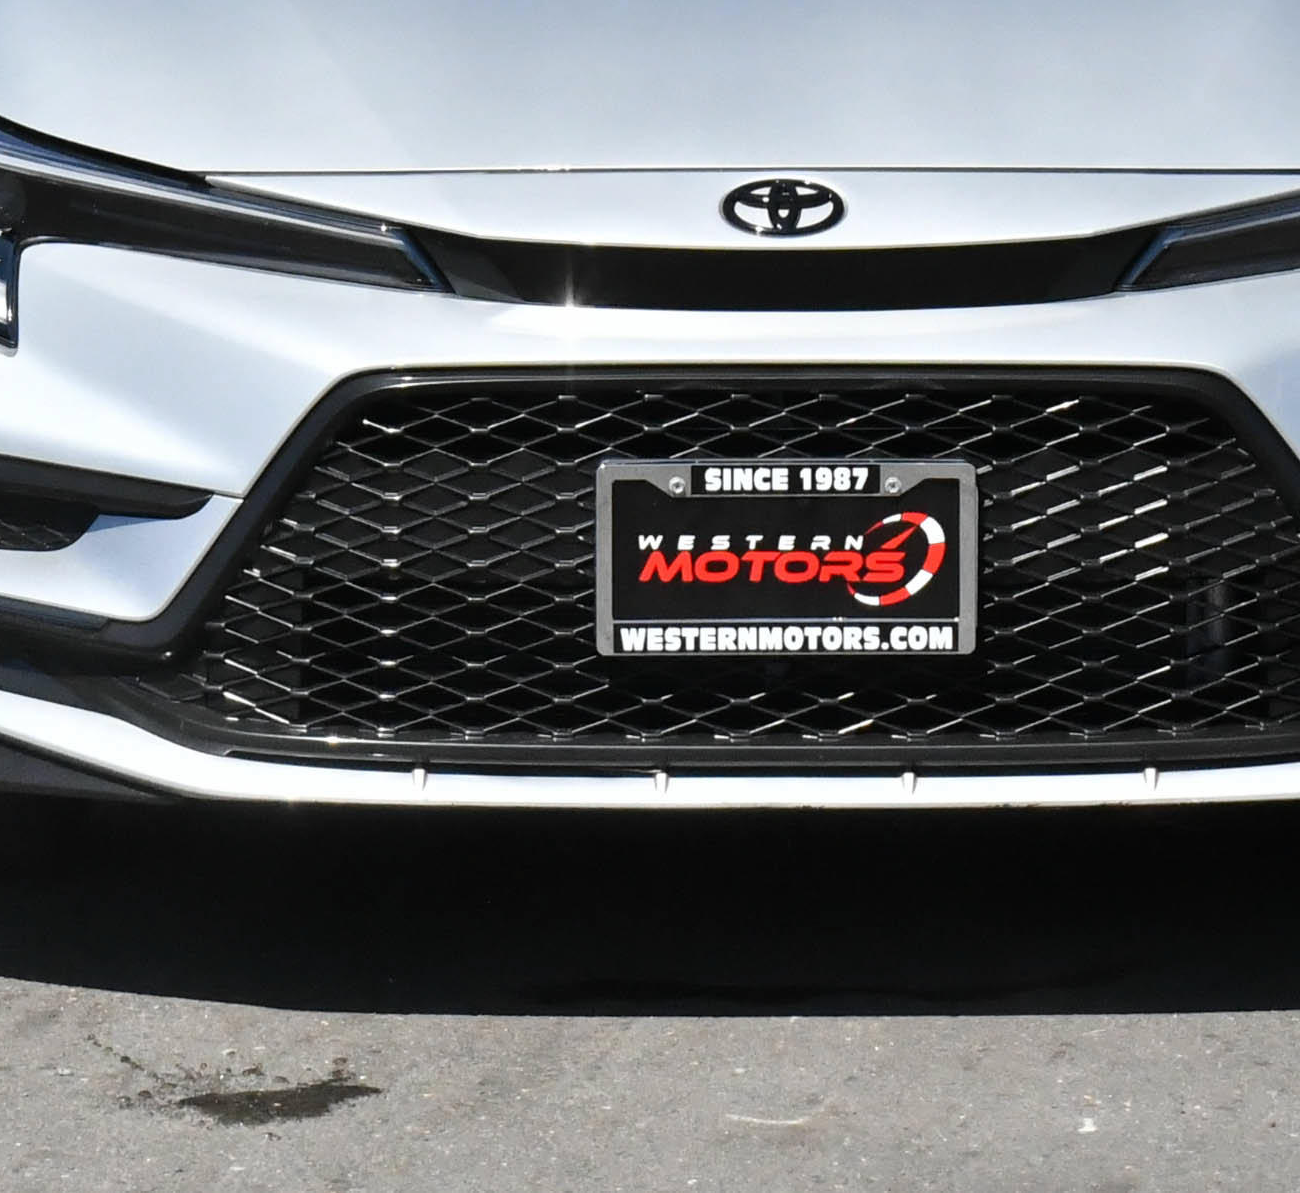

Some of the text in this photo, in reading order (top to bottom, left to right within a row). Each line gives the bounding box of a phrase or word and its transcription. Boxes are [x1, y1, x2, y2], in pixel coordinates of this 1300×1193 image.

[704, 466, 869, 492] SINCE 1987
[638, 534, 864, 551] WESTERN
[638, 550, 906, 584] MOTORS
[619, 625, 953, 652] WESTERNMOTORS.COM
